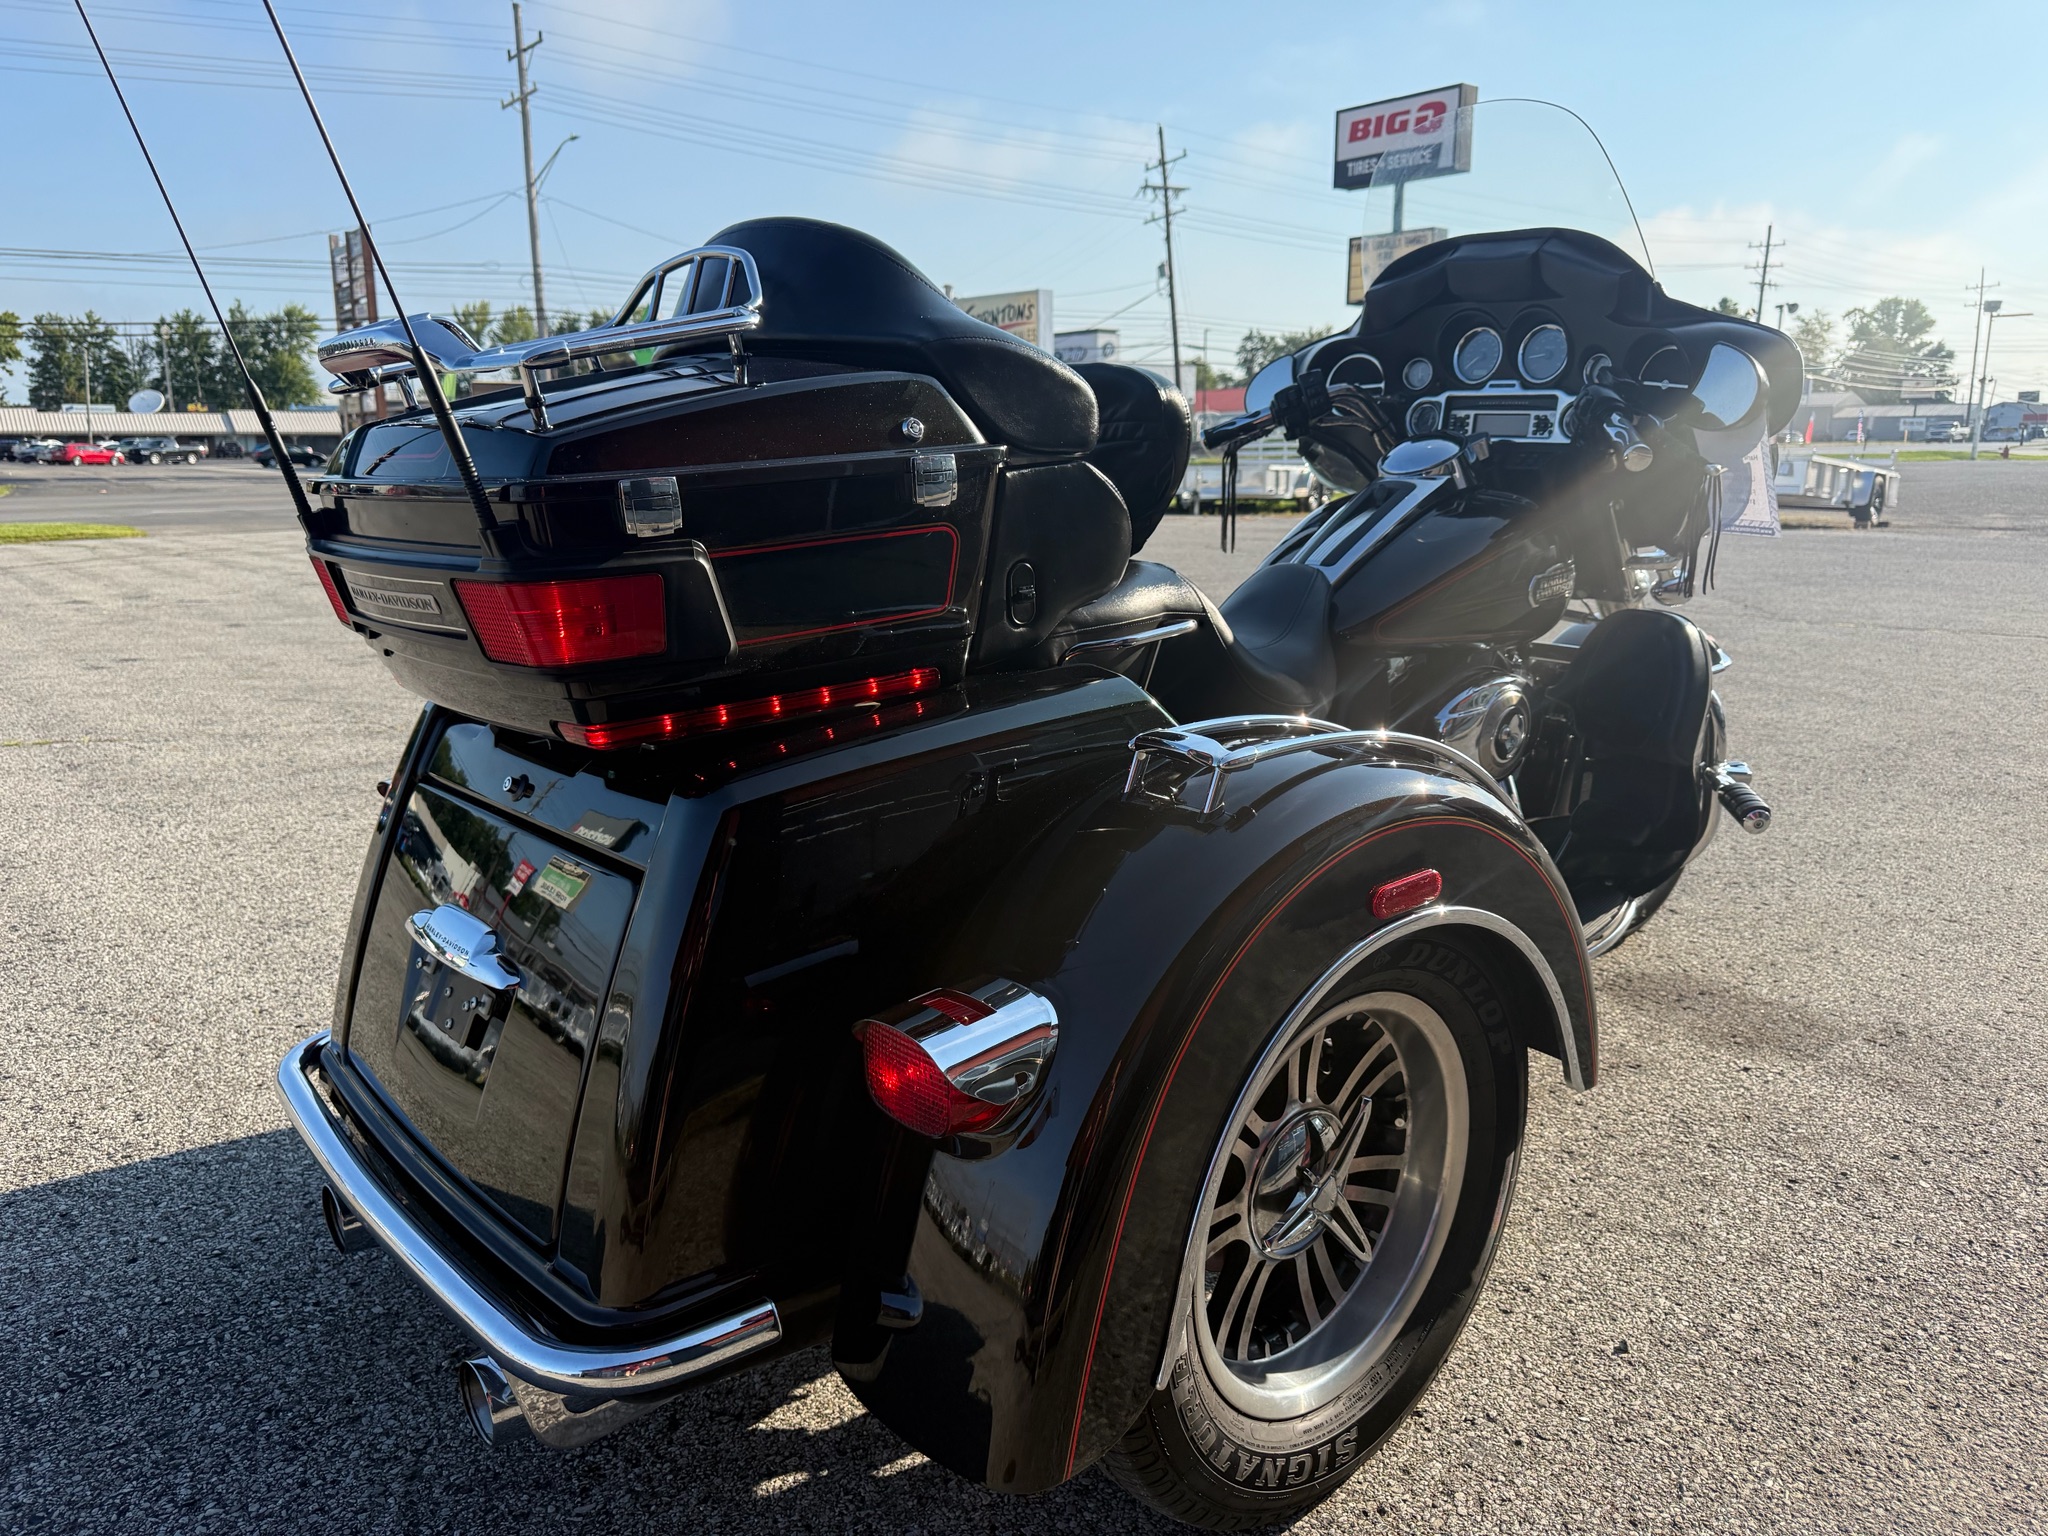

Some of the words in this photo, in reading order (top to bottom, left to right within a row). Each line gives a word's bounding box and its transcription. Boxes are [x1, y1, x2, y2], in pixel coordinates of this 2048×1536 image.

[1348, 109, 1411, 143] BIG
[1346, 157, 1378, 177] TIRES
[1386, 149, 1433, 170] SERVICE
[351, 586, 434, 611] HARLEY-DAVIDSON
[425, 922, 470, 956] HARLEY-DAVIDSON
[1398, 942, 1513, 1055] DUNLOP
[1171, 1350, 1360, 1488] SIGNATURE
